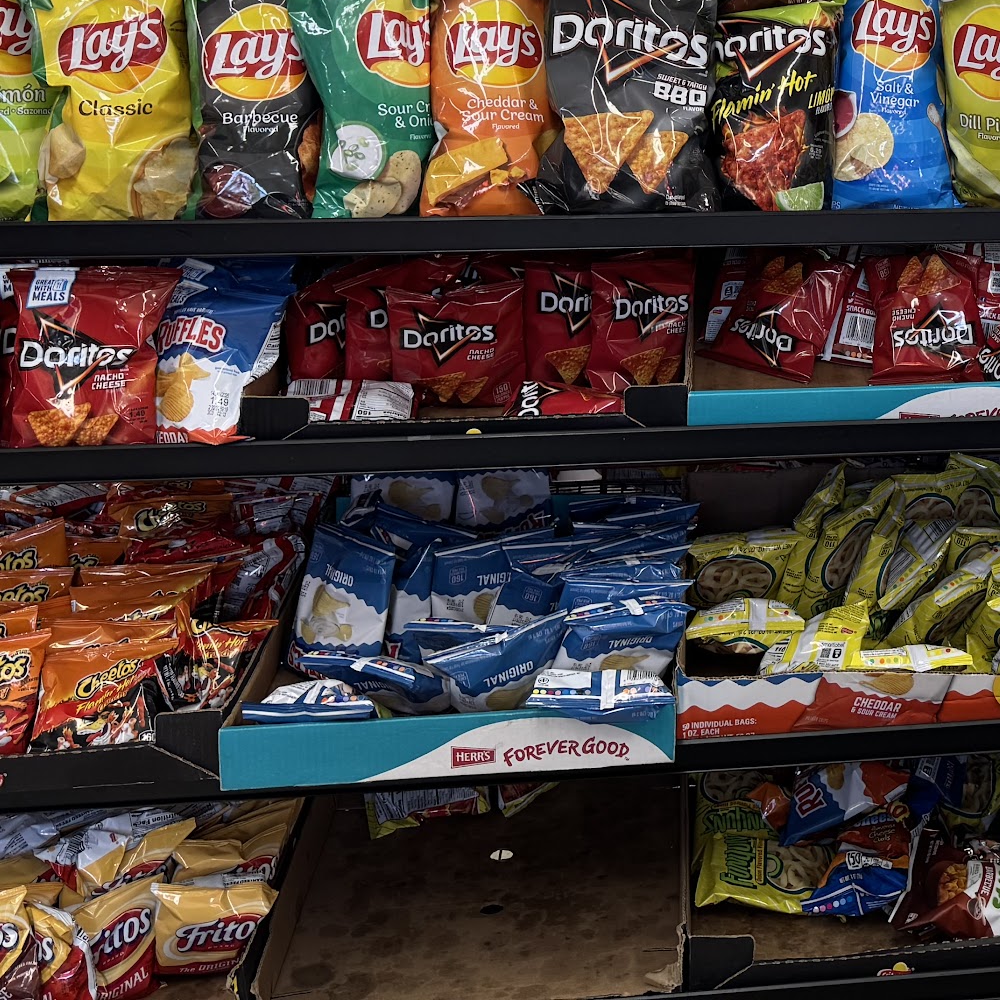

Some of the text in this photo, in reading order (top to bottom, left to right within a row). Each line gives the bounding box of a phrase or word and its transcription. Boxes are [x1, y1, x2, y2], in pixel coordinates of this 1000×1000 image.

[855, 0, 933, 53] Lay's
[69, 8, 160, 73] Lay's
[453, 21, 535, 67] Lay's
[552, 13, 708, 68] Doritos
[657, 74, 707, 90] SWEET TANGY
[778, 70, 817, 96] Hot
[877, 80, 914, 95] Salt &
[467, 95, 538, 109] Cheddar &
[654, 82, 707, 106] BBQ
[870, 92, 919, 111] Vinegar
[78, 99, 153, 117] Classic
[378, 104, 412, 116] Sour
[462, 109, 544, 122] Sour Cream
[222, 111, 298, 125] Barbecue
[395, 116, 405, 128] &
[960, 113, 982, 130] Dill
[492, 123, 520, 131] Flavored
[32, 291, 66, 301] MEALS
[614, 292, 689, 321] Doritos
[158, 315, 225, 352] RUFFLES
[403, 324, 496, 350] Doritos
[893, 322, 974, 350] Doritos
[19, 340, 136, 369] Doritos
[91, 380, 127, 390] CHEESE
[94, 373, 124, 381] NACHO
[608, 635, 653, 649] ORIGINAL
[75, 658, 144, 699] Cheetos
[484, 660, 535, 689] ORIGINAL
[854, 697, 902, 713] CHEDDAR
[857, 708, 897, 719] SOUR CREAM
[691, 720, 733, 729] INDIVIDUAL
[701, 728, 720, 736] EACH
[455, 736, 630, 767] HERR'S FOREVER GOOD
